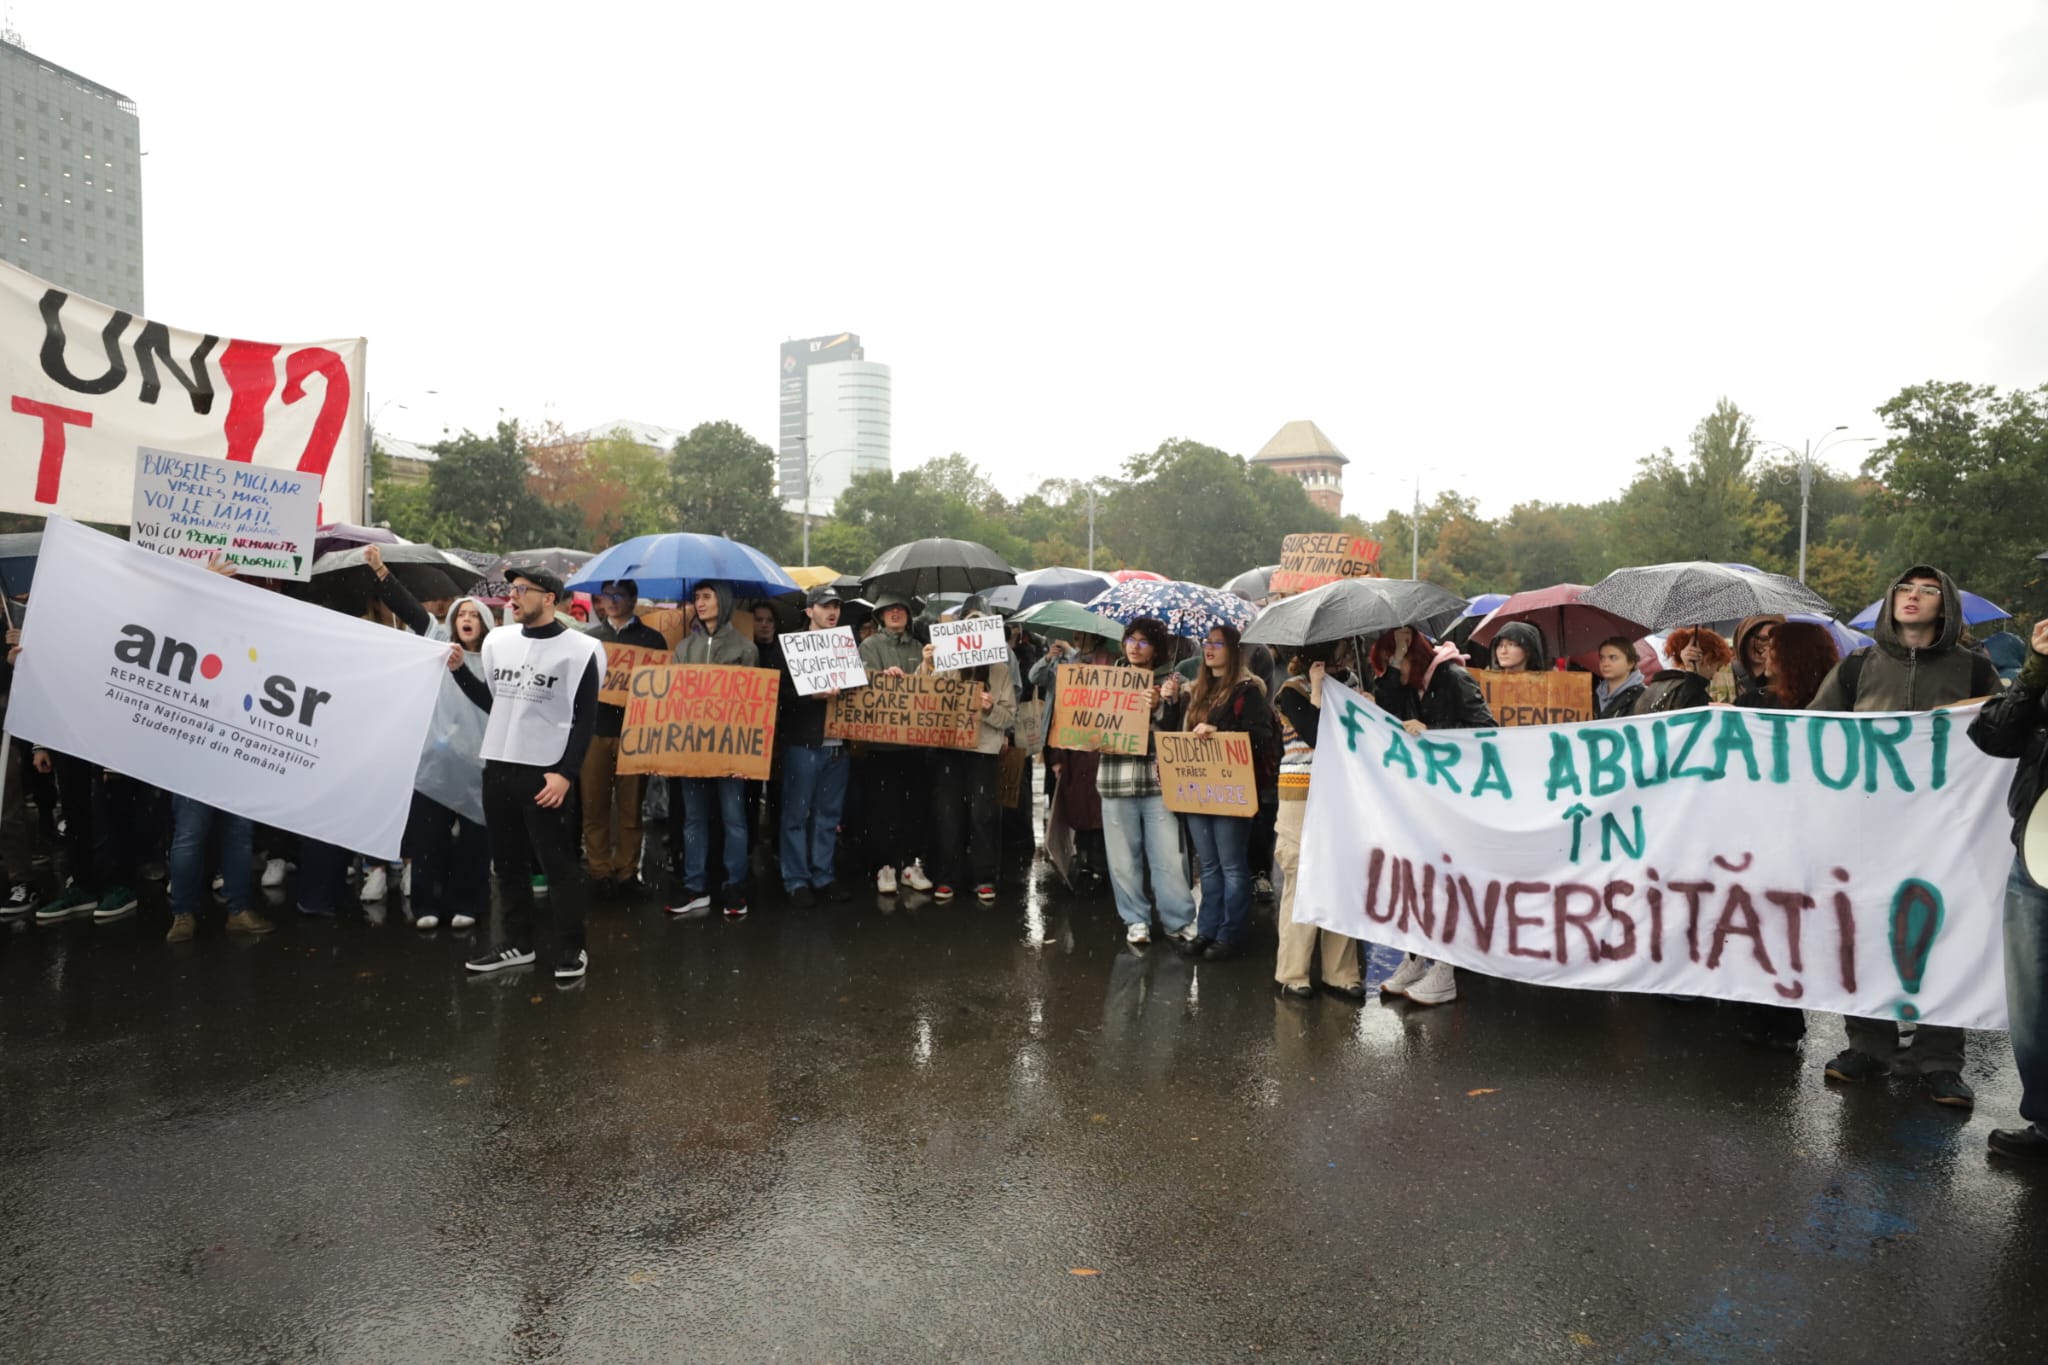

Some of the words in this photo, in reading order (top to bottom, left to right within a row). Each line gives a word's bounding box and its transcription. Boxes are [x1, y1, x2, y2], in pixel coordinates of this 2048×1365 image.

[144, 490, 175, 510] VOI
[182, 497, 205, 516] LE
[136, 521, 160, 538] VOI
[163, 525, 182, 539] CU
[158, 543, 175, 556] CU
[1350, 540, 1382, 563] NU
[783, 633, 830, 654] PENTRU
[956, 634, 983, 652] NU
[936, 646, 1008, 669] AUSTERITATE
[110, 667, 210, 709] REPREZENTĂM
[632, 669, 670, 699] CU
[934, 678, 980, 697] COST
[1121, 670, 1150, 690] DIN
[835, 692, 856, 708] PE
[862, 691, 909, 710] CARE
[913, 696, 937, 711] NU
[834, 708, 911, 726] PERMITEM
[916, 712, 949, 727] ESTE
[1071, 710, 1092, 726] NU
[1094, 712, 1124, 730] DIN
[105, 688, 150, 712] Alianța
[154, 704, 214, 733] Națională
[218, 729, 227, 737] a
[230, 731, 317, 771] Organizațiilor
[249, 715, 319, 749] VIITORUL!
[620, 726, 664, 756] CUM
[131, 712, 206, 746] Studențești
[209, 740, 230, 755] din
[233, 749, 287, 776] România
[1225, 739, 1250, 765] NU
[1545, 707, 1951, 801] ABUZATORI
[1221, 768, 1233, 778] CU
[1176, 781, 1249, 805] APLAUZE
[1562, 802, 1647, 864] ÎN
